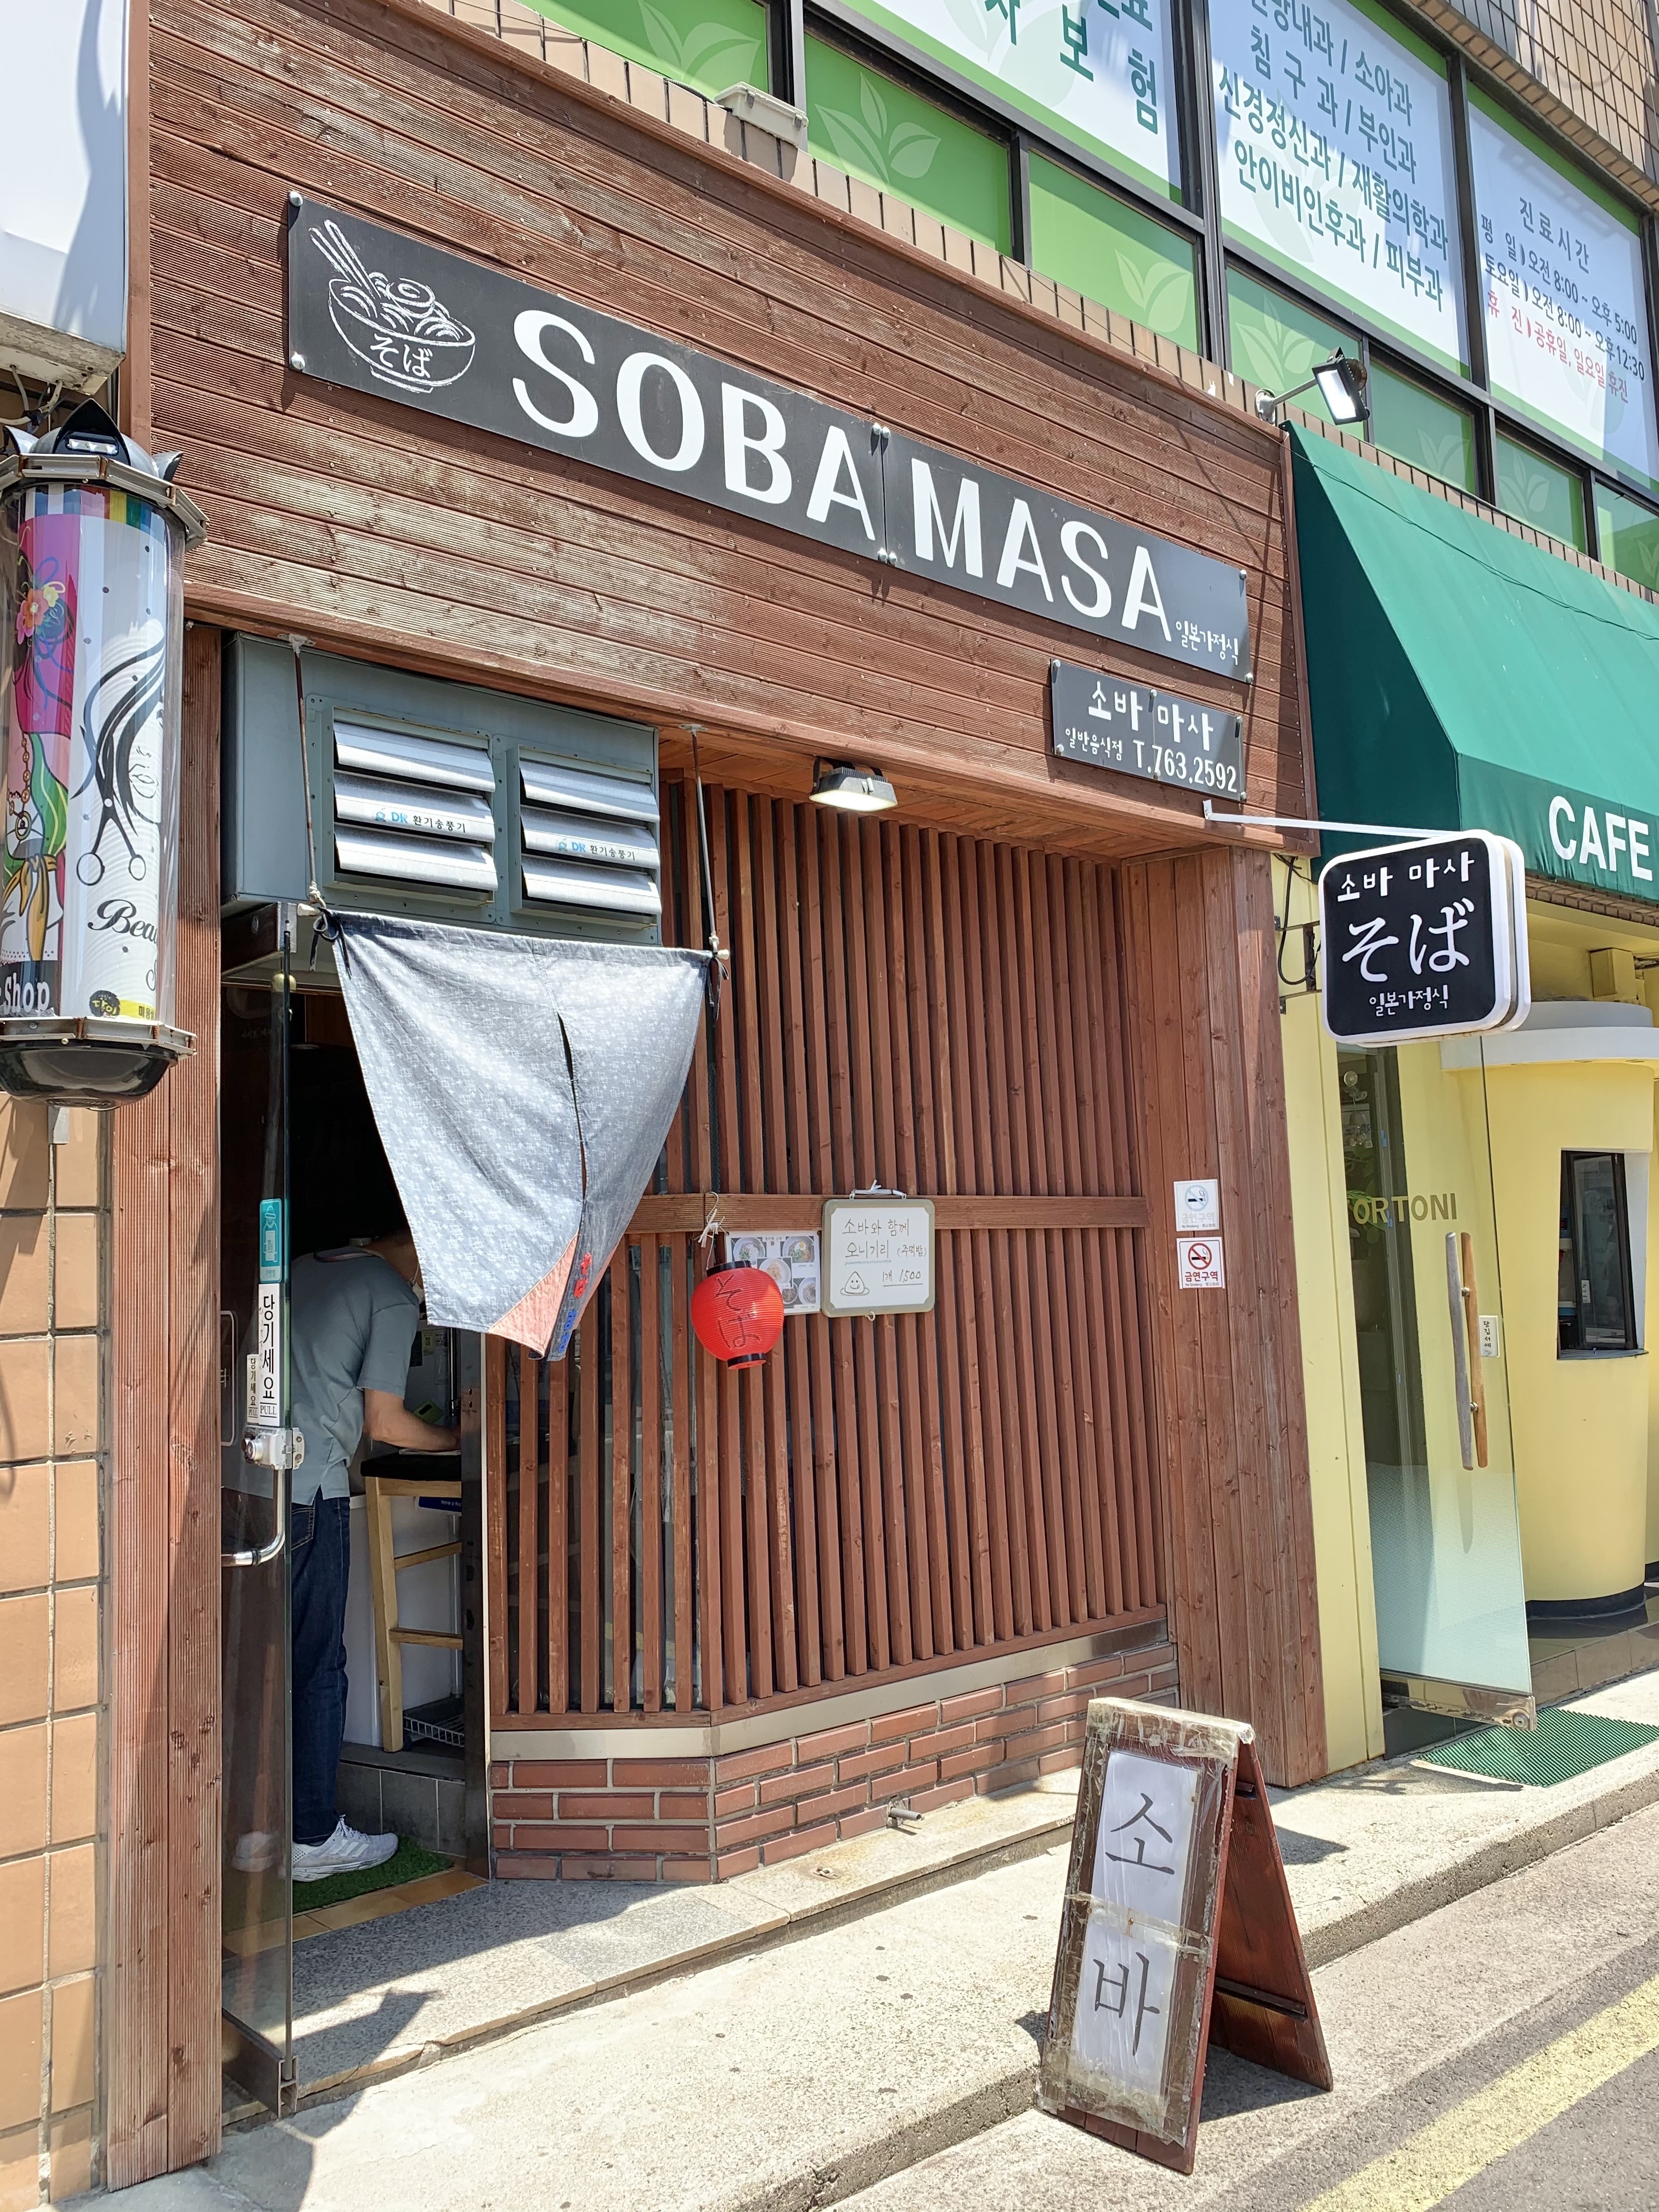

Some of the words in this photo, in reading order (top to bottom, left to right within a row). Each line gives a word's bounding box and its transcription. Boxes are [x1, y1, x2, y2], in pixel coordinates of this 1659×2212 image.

[1355, 50, 1413, 127] 소아과
[1219, 66, 1331, 181] 신경정신과
[1352, 159, 1448, 261] 재활의학과
[1359, 105, 1417, 184] 부인과
[1234, 140, 1366, 263] 안이비인후과
[1385, 240, 1443, 312] 피부과
[1485, 252, 1520, 299] 토요일
[1532, 286, 1554, 321] 오전
[1557, 305, 1582, 339] 8:00
[1528, 250, 1551, 285] 오전
[1554, 270, 1578, 304] 8:00
[1592, 295, 1612, 327] 오후
[1615, 312, 1637, 345] 5:00
[370, 332, 433, 379] そば
[1574, 347, 1606, 390] 일요일
[1608, 371, 1628, 404] 휴진
[512, 310, 876, 541] SOBA
[911, 458, 1172, 642] MASA
[1176, 620, 1238, 665] 일본가정식
[1065, 727, 1122, 761] 일반음식점
[1088, 681, 1143, 731] 소바
[1157, 704, 1214, 752] 마사
[413, 815, 466, 833] 환기송풍기
[1549, 795, 1653, 882] CAFE
[590, 845, 635, 861] 환기송풍기
[1338, 866, 1393, 902] 소바
[1409, 851, 1475, 888] 마사
[1341, 897, 1475, 982] そば
[1369, 984, 1449, 1017] 일본가정식
[842, 1218, 882, 1235] 소바와
[888, 1218, 910, 1237] 함께
[1182, 1212, 1215, 1224] 금연구역
[1347, 1193, 1457, 1224] ORTONI
[845, 1239, 889, 1259] 오니기리
[1184, 1271, 1218, 1282] 금연구역
[715, 1274, 761, 1351] そば
[263, 1294, 275, 1399] 당기세요
[260, 1405, 277, 1415] PULL
[1093, 1792, 1175, 2057] 소바
